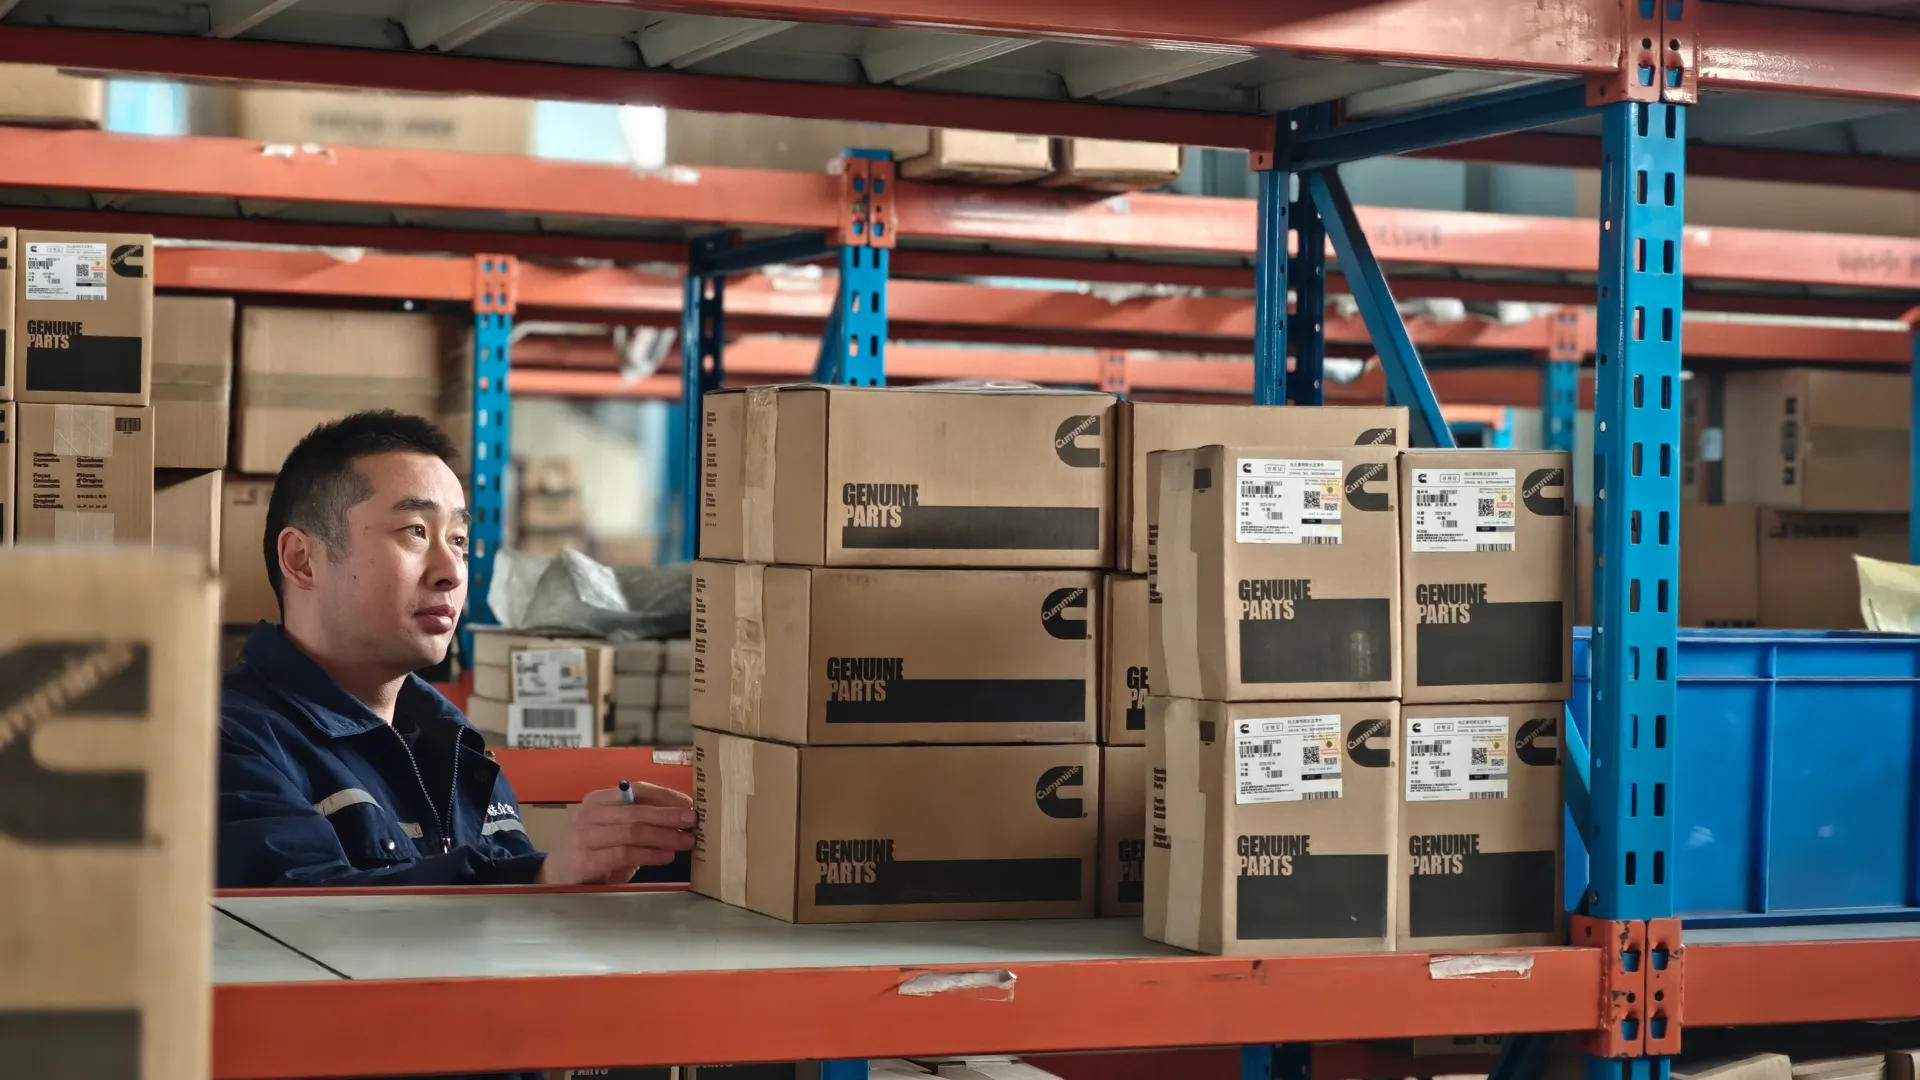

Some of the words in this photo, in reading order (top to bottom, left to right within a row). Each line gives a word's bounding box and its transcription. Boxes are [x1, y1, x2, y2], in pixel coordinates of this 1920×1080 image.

[27, 320, 83, 335] GENUINE
[28, 334, 70, 349] PARTS
[1055, 416, 1097, 449] Cummins
[1369, 428, 1393, 445] mins
[1345, 463, 1385, 494] Cummins
[1523, 468, 1561, 499] Cummins
[843, 483, 919, 506] GENUINE
[843, 506, 902, 528] PARTS
[1239, 579, 1311, 600] GENUINE
[1416, 583, 1487, 604] GENUINE
[1042, 588, 1084, 621] Cummins
[1239, 600, 1294, 620] PARTS
[1416, 604, 1470, 624] PARTS
[827, 657, 904, 681] GENUINE
[827, 680, 886, 702] PARTS
[1347, 719, 1388, 750] Cummins
[1036, 765, 1079, 800] Cummins
[815, 839, 894, 863] GENUINE
[1237, 835, 1310, 856] GENUINE
[1409, 834, 1480, 855] GENUINE
[815, 862, 877, 884] PARTS
[1238, 856, 1293, 876] PARTS
[1410, 855, 1463, 875] PARTS
